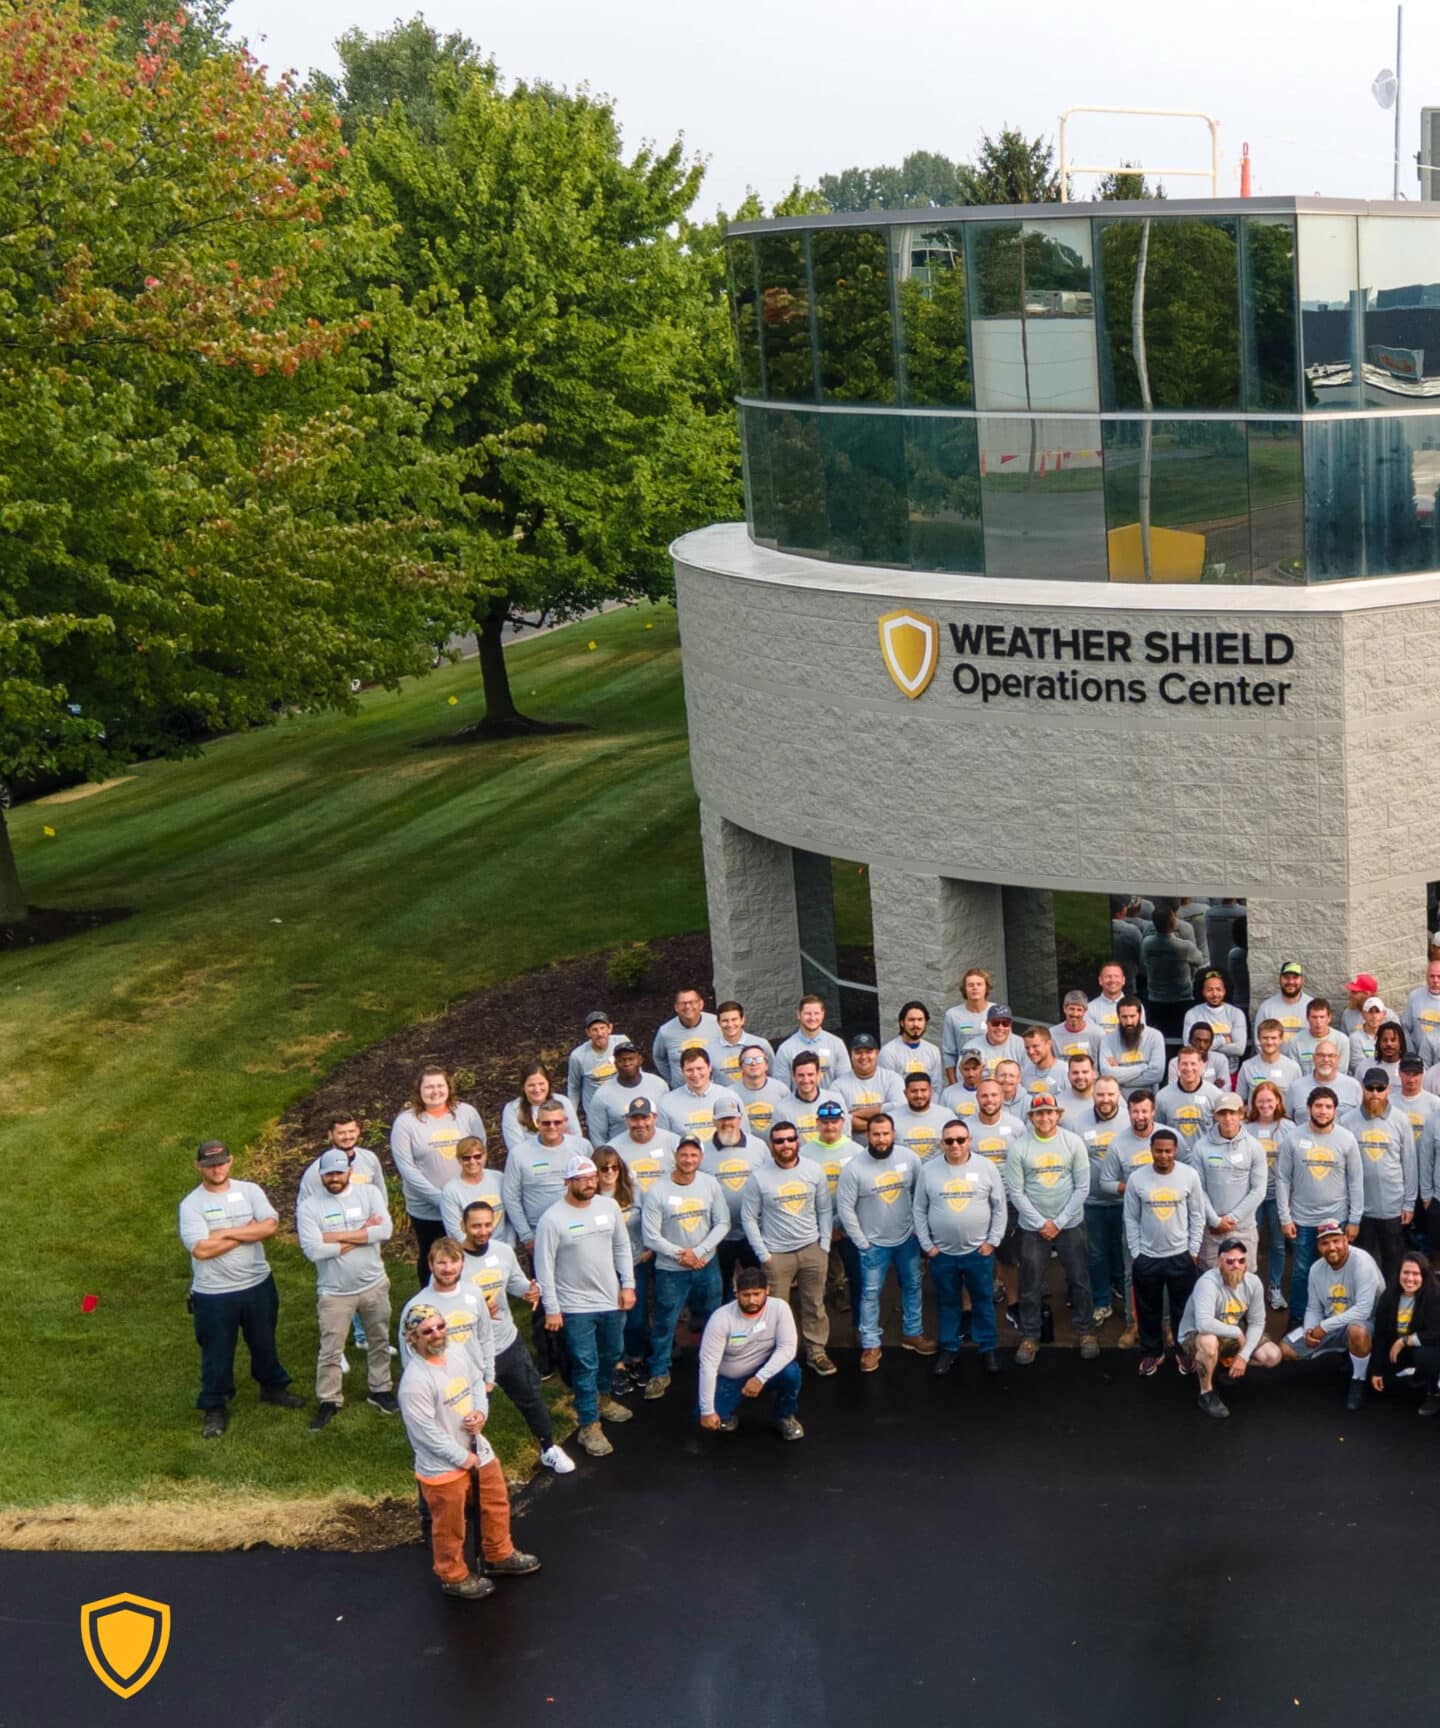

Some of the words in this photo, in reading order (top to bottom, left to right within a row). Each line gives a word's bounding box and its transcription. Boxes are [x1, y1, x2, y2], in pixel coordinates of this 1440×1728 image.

[949, 623, 1132, 664] WEATHER
[1145, 631, 1294, 666] SHIELD
[952, 663, 1147, 703] Operations
[1159, 673, 1291, 706] Center
